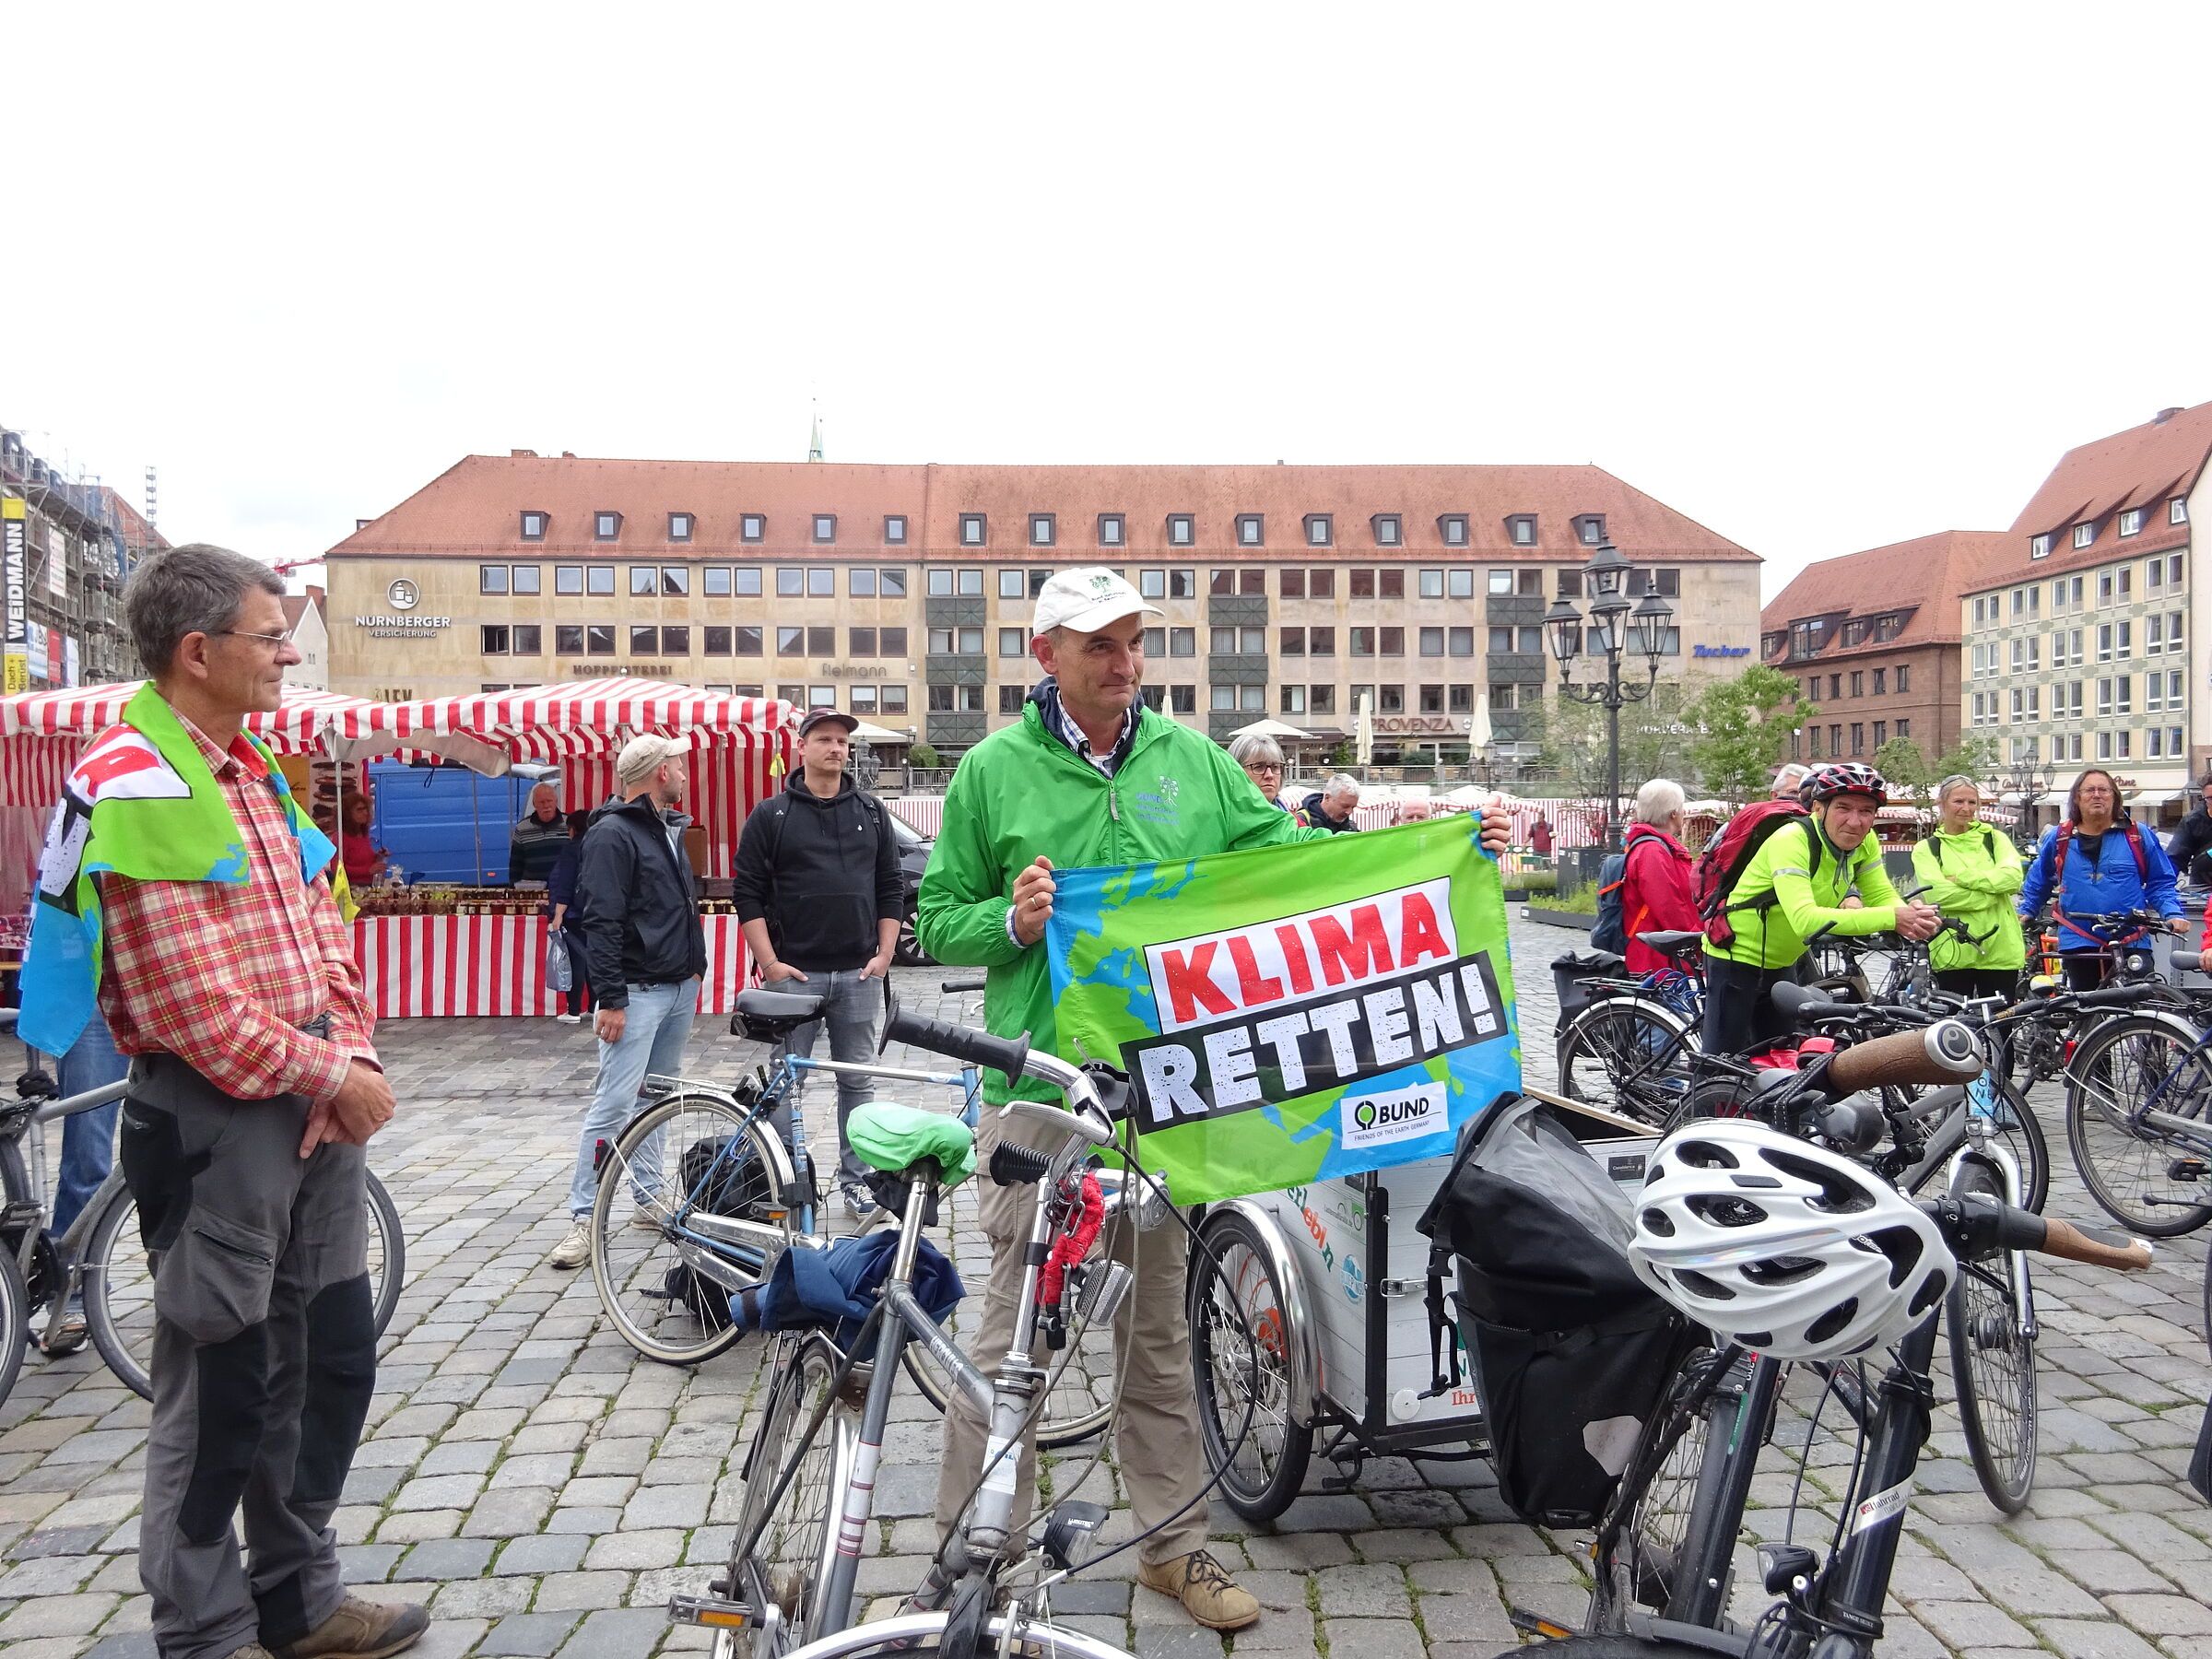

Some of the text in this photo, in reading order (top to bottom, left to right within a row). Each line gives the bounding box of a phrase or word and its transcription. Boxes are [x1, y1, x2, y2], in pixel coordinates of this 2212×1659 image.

[355, 615, 451, 628] NÜRNBERGER
[369, 629, 437, 638] VERSICHERUNG
[1693, 644, 1750, 657] Tucher
[572, 665, 673, 676] HOFPFSTEREI
[1371, 717, 1454, 732] PROVENZA
[1160, 891, 1451, 1024] KLIMA
[1138, 963, 1497, 1123] RETTEN!
[1379, 1097, 1430, 1124] BUND
[1354, 1132, 1375, 1141] FRIENDS
[1394, 1125, 1409, 1134] EARTH
